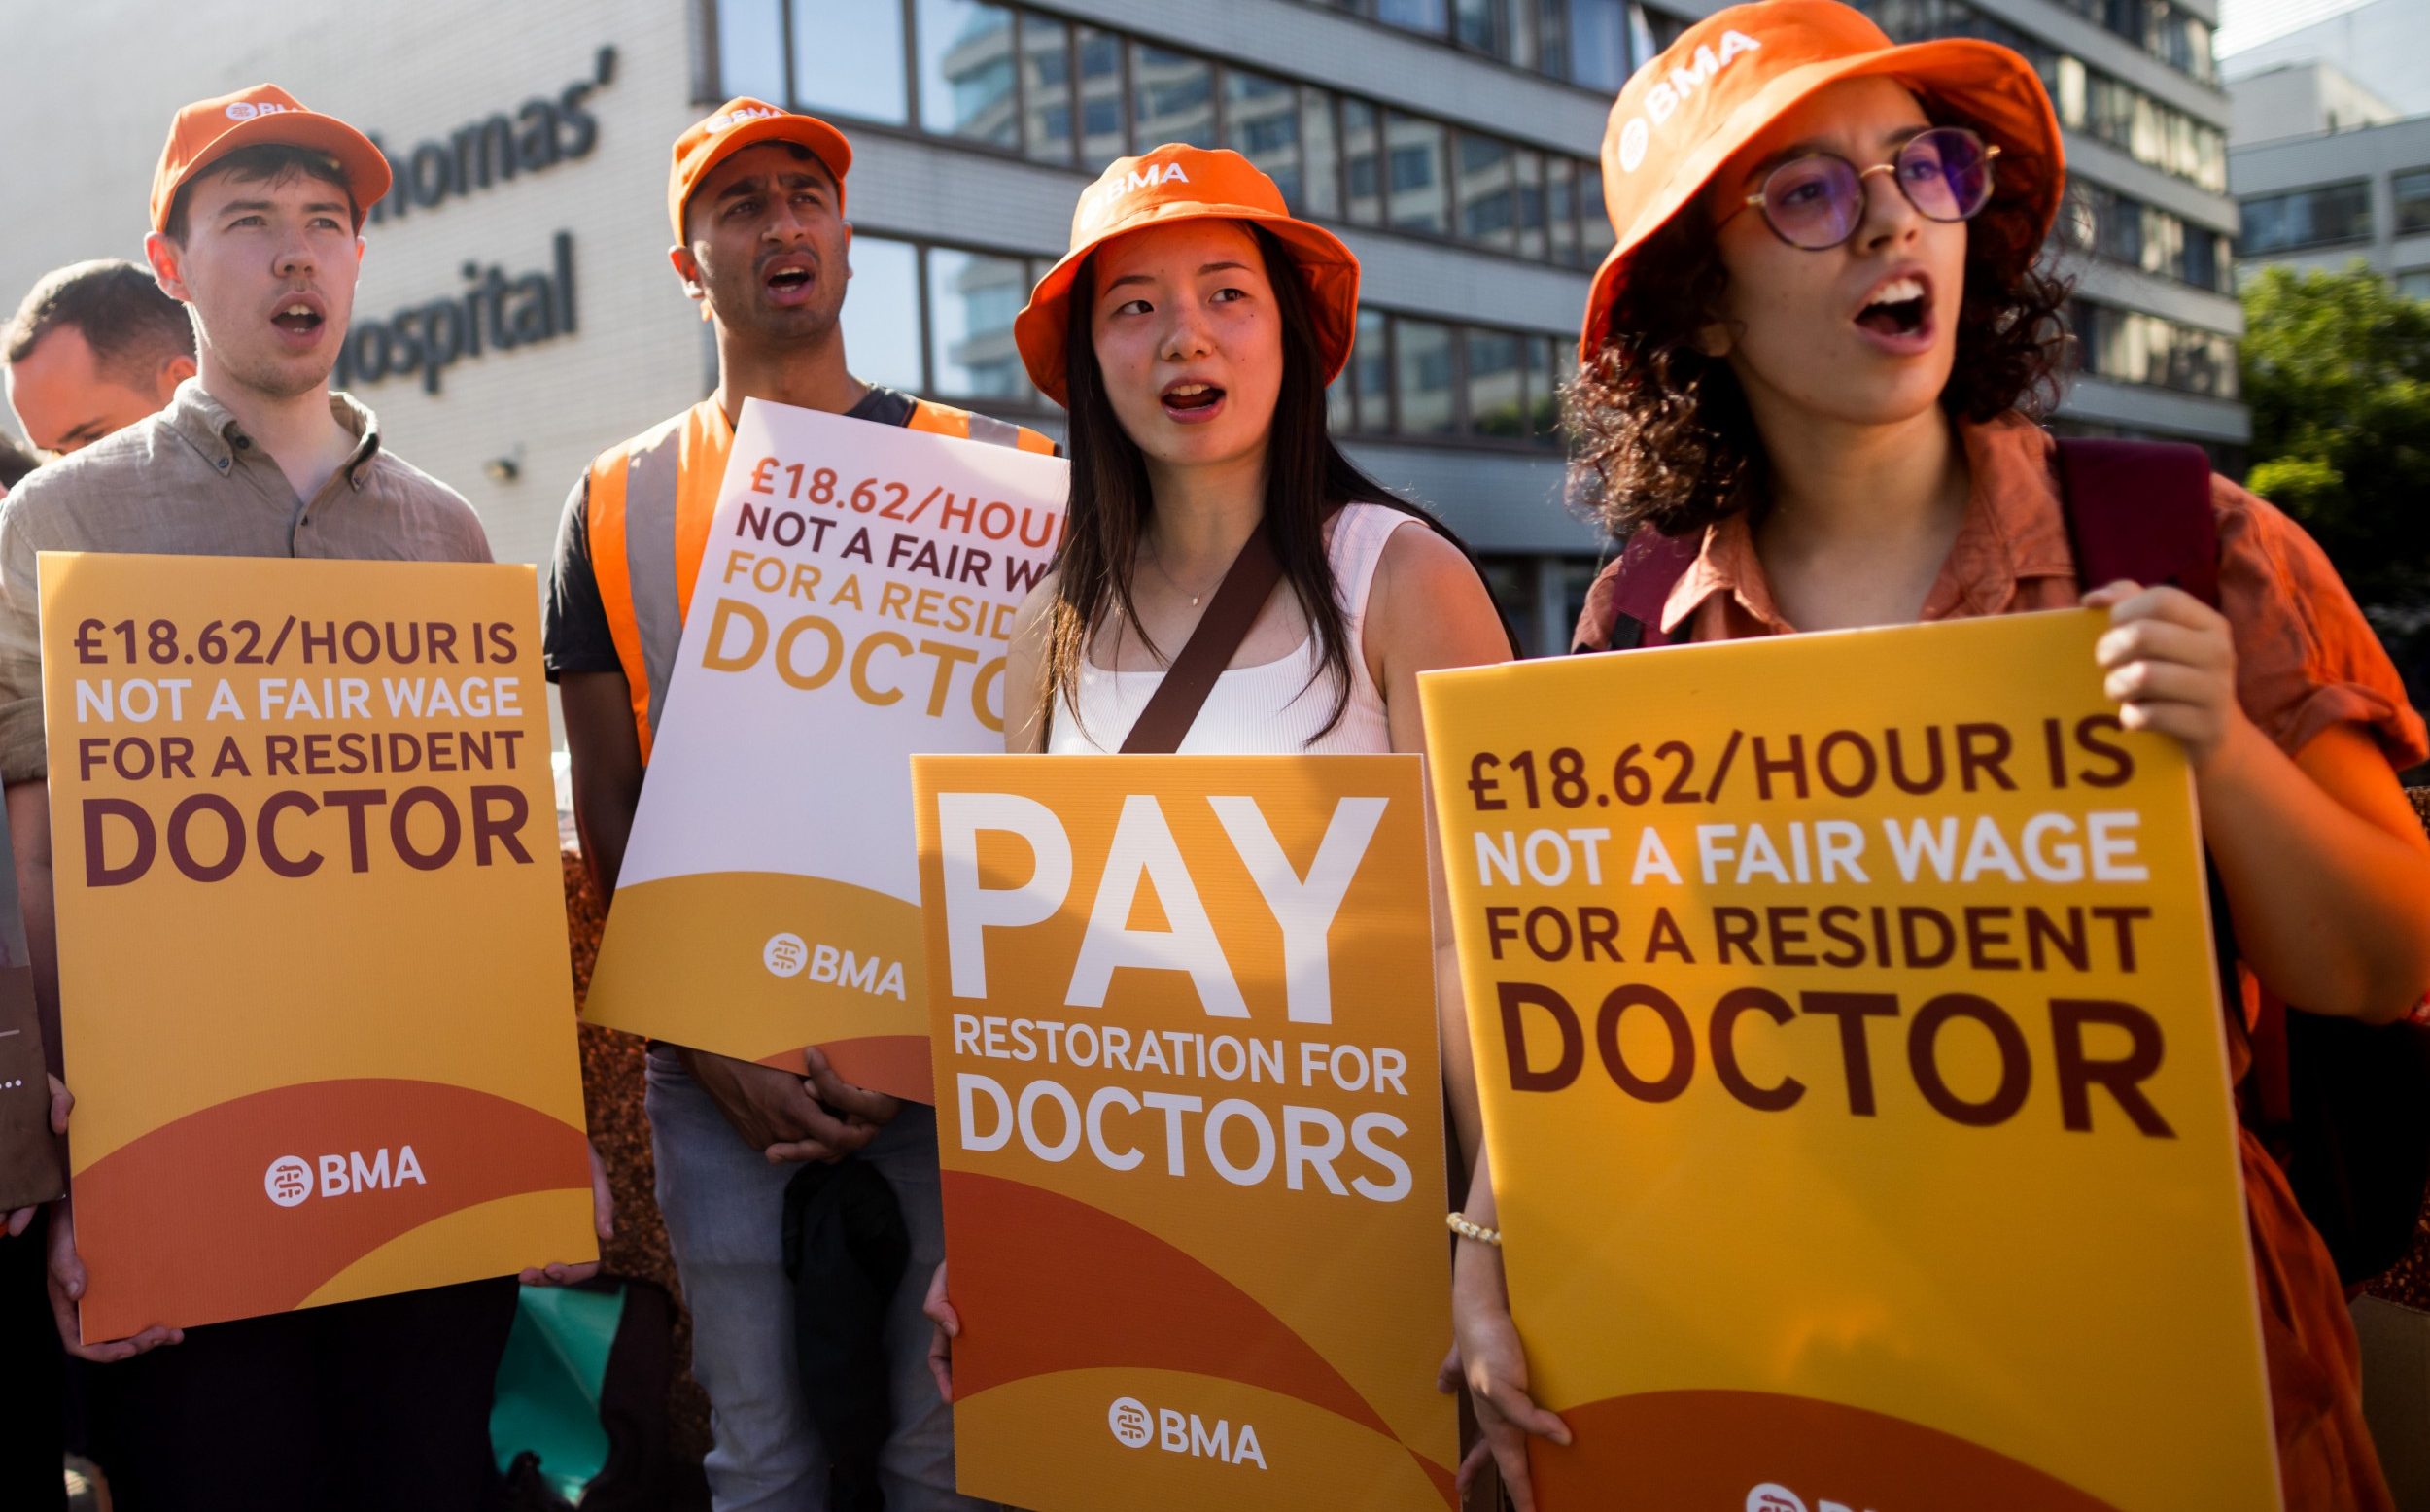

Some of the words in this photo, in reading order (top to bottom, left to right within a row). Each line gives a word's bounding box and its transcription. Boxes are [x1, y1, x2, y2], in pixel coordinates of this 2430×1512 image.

[1644, 30, 1762, 126] BMA
[1106, 162, 1190, 204] BMA
[722, 549, 823, 601] FOR
[829, 573, 863, 611] A
[735, 501, 837, 553] NOT
[840, 526, 874, 564] A
[886, 533, 992, 587] FAIR
[74, 614, 459, 666] £18.62/HOUR
[472, 621, 518, 664] IS
[75, 677, 192, 723] NOT
[206, 678, 246, 721] A
[260, 676, 372, 719] FAIR
[382, 676, 523, 718] WAGE
[78, 736, 196, 782] FOR
[210, 735, 251, 777] A
[265, 729, 524, 775] RESIDENT
[1468, 720, 2020, 812] £18.62/HOUR
[2043, 712, 2135, 789] IS
[82, 784, 535, 887] DOCTOR
[1473, 826, 1612, 887] NOT
[1630, 826, 1683, 885] A
[1695, 819, 1868, 885] FAIR
[1882, 809, 2151, 884] WAGE
[937, 791, 1390, 1025] PAY
[1484, 905, 1625, 963] FOR
[1644, 906, 1697, 965] A
[1711, 905, 2153, 975] RESIDENT
[809, 944, 907, 1002] BMA
[953, 1013, 1286, 1085] RESTORATION
[1300, 1041, 1409, 1096] FOR
[1495, 980, 2179, 1140] DOCTOR
[319, 1145, 427, 1198] BMA
[955, 1072, 1413, 1203] DOCTORS
[1159, 1408, 1268, 1470] BMA
